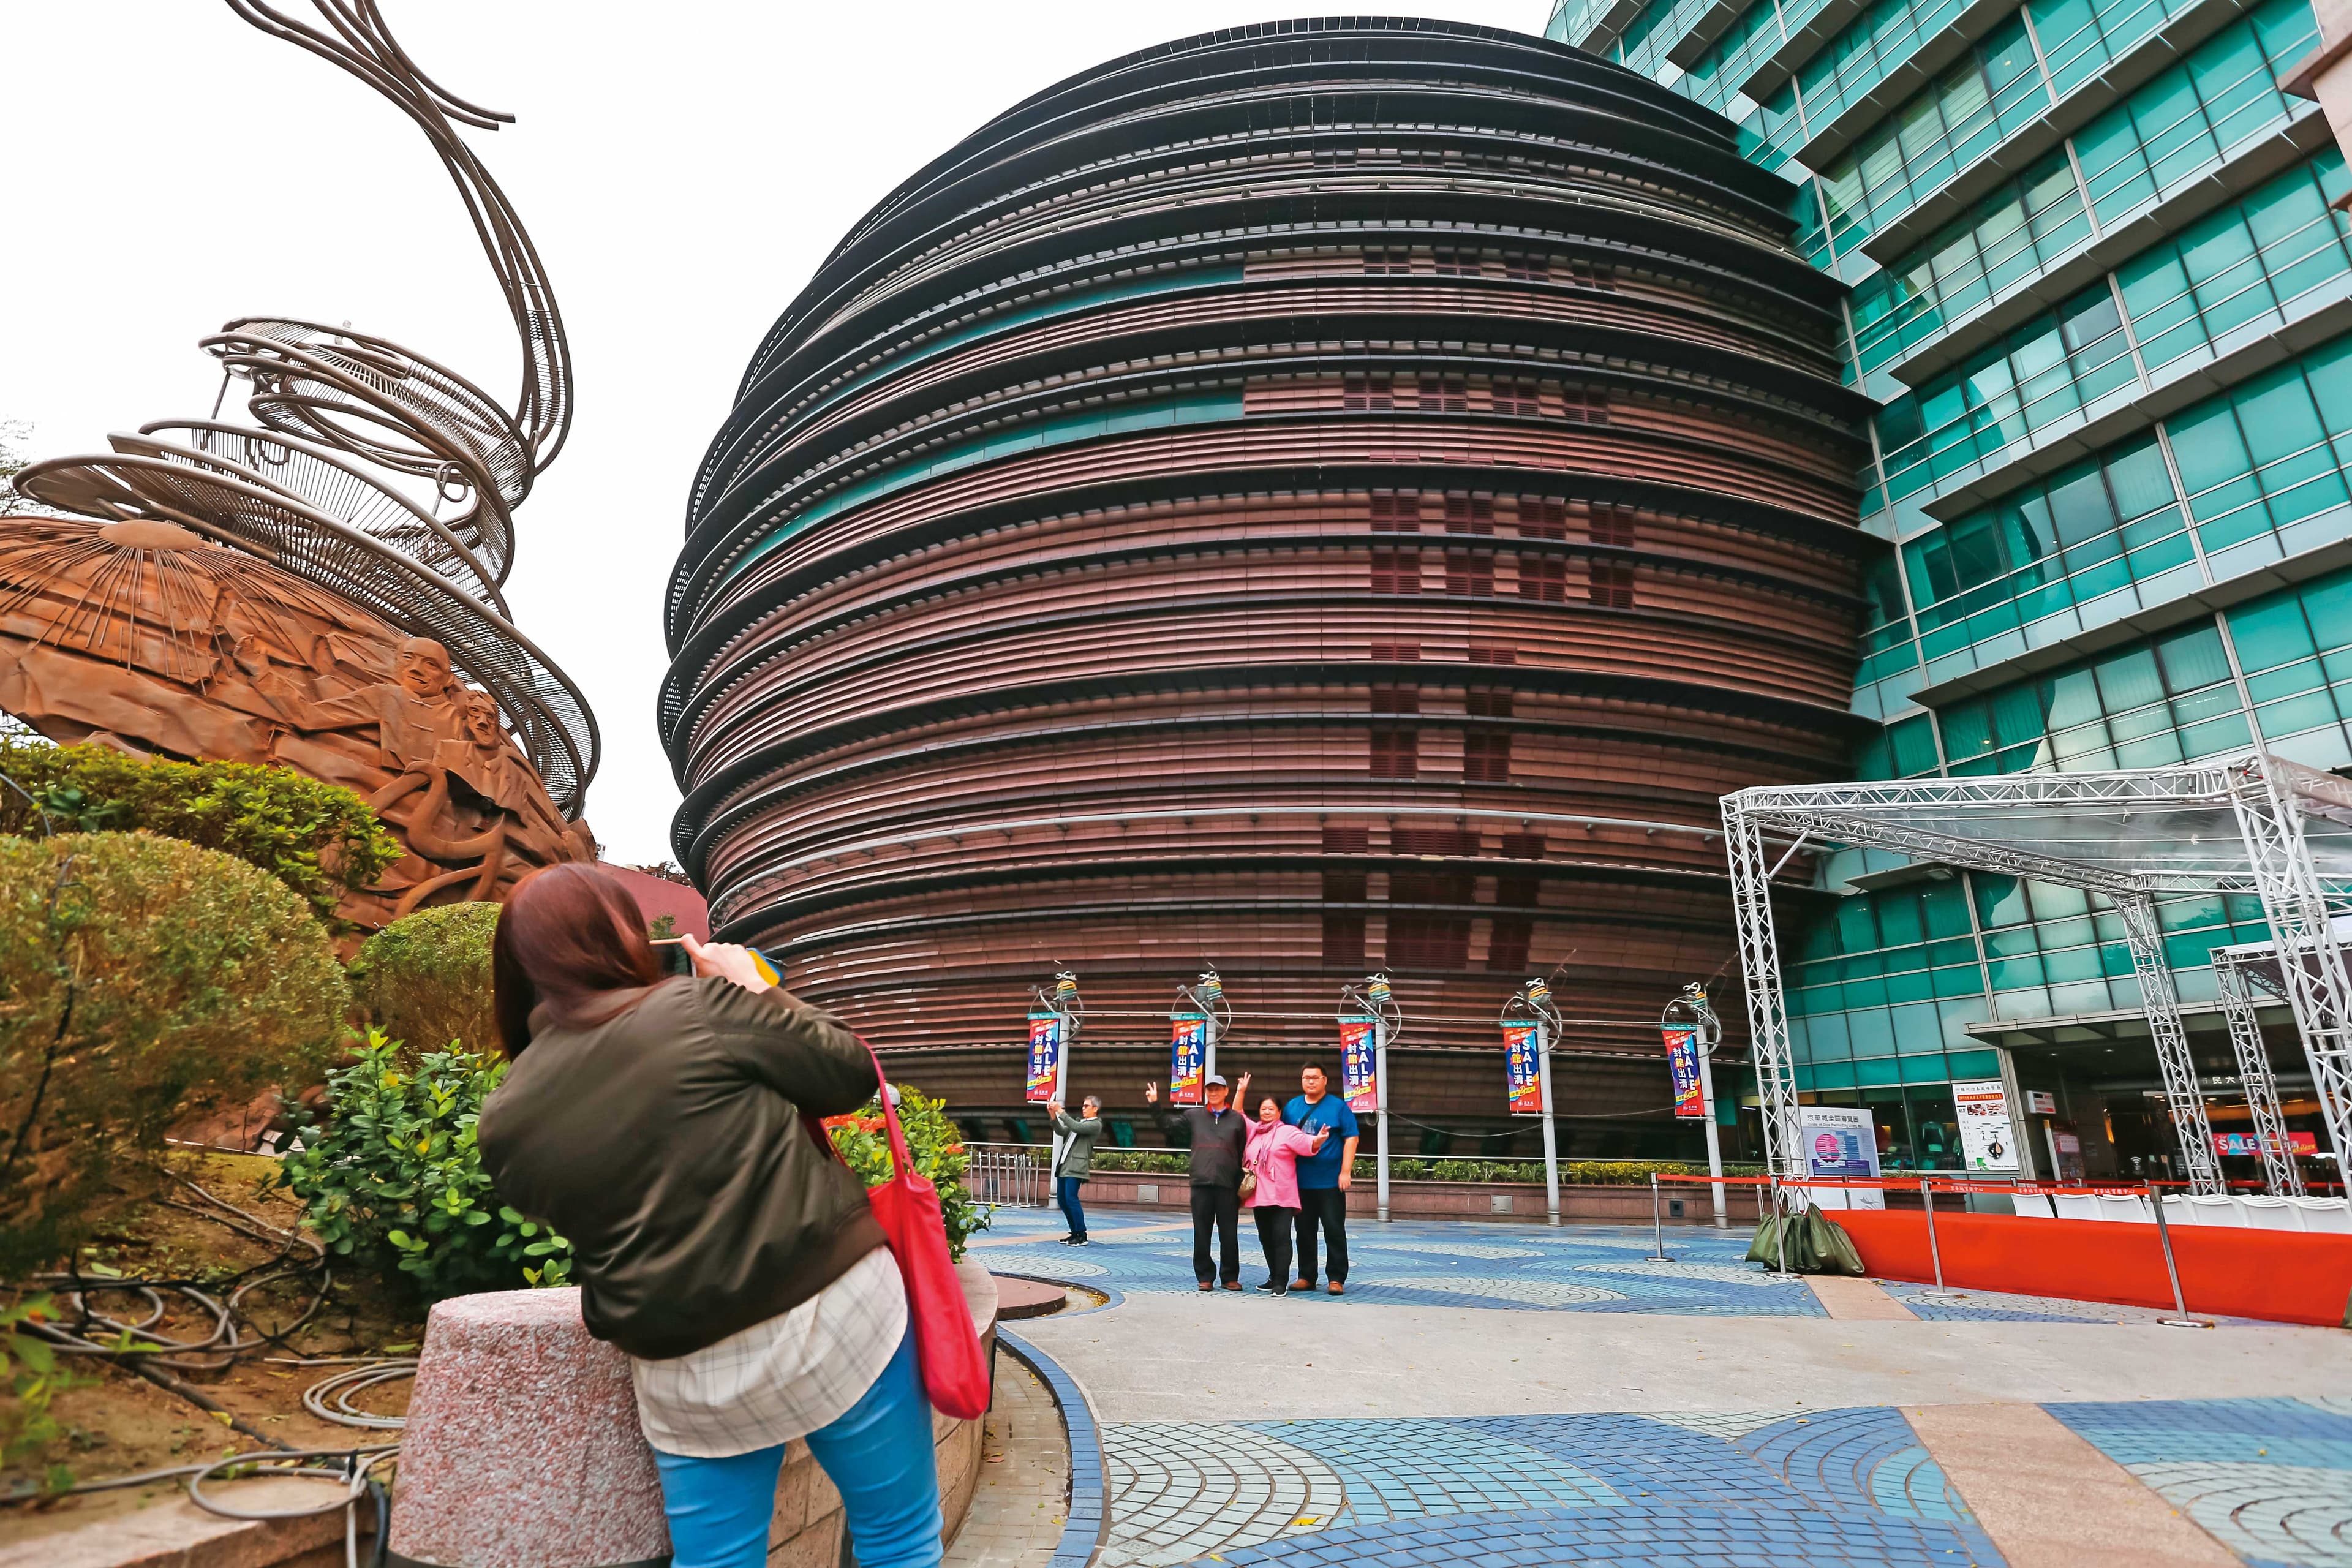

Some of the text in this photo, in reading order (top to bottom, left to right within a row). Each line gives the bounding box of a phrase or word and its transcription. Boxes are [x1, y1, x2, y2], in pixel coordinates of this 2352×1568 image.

[1043, 1030, 1053, 1076] SALE
[1188, 1032, 1199, 1078] SALE
[1348, 1044, 1359, 1085] 封館出清
[1359, 1039, 1369, 1087] SALE
[1511, 1043, 1523, 1085] 封館出清
[1522, 1039, 1533, 1086] SALE
[1673, 1047, 1687, 1088] 封館出清
[1683, 1044, 1696, 1090] SALE
[2218, 1138, 2256, 1150] SALE
